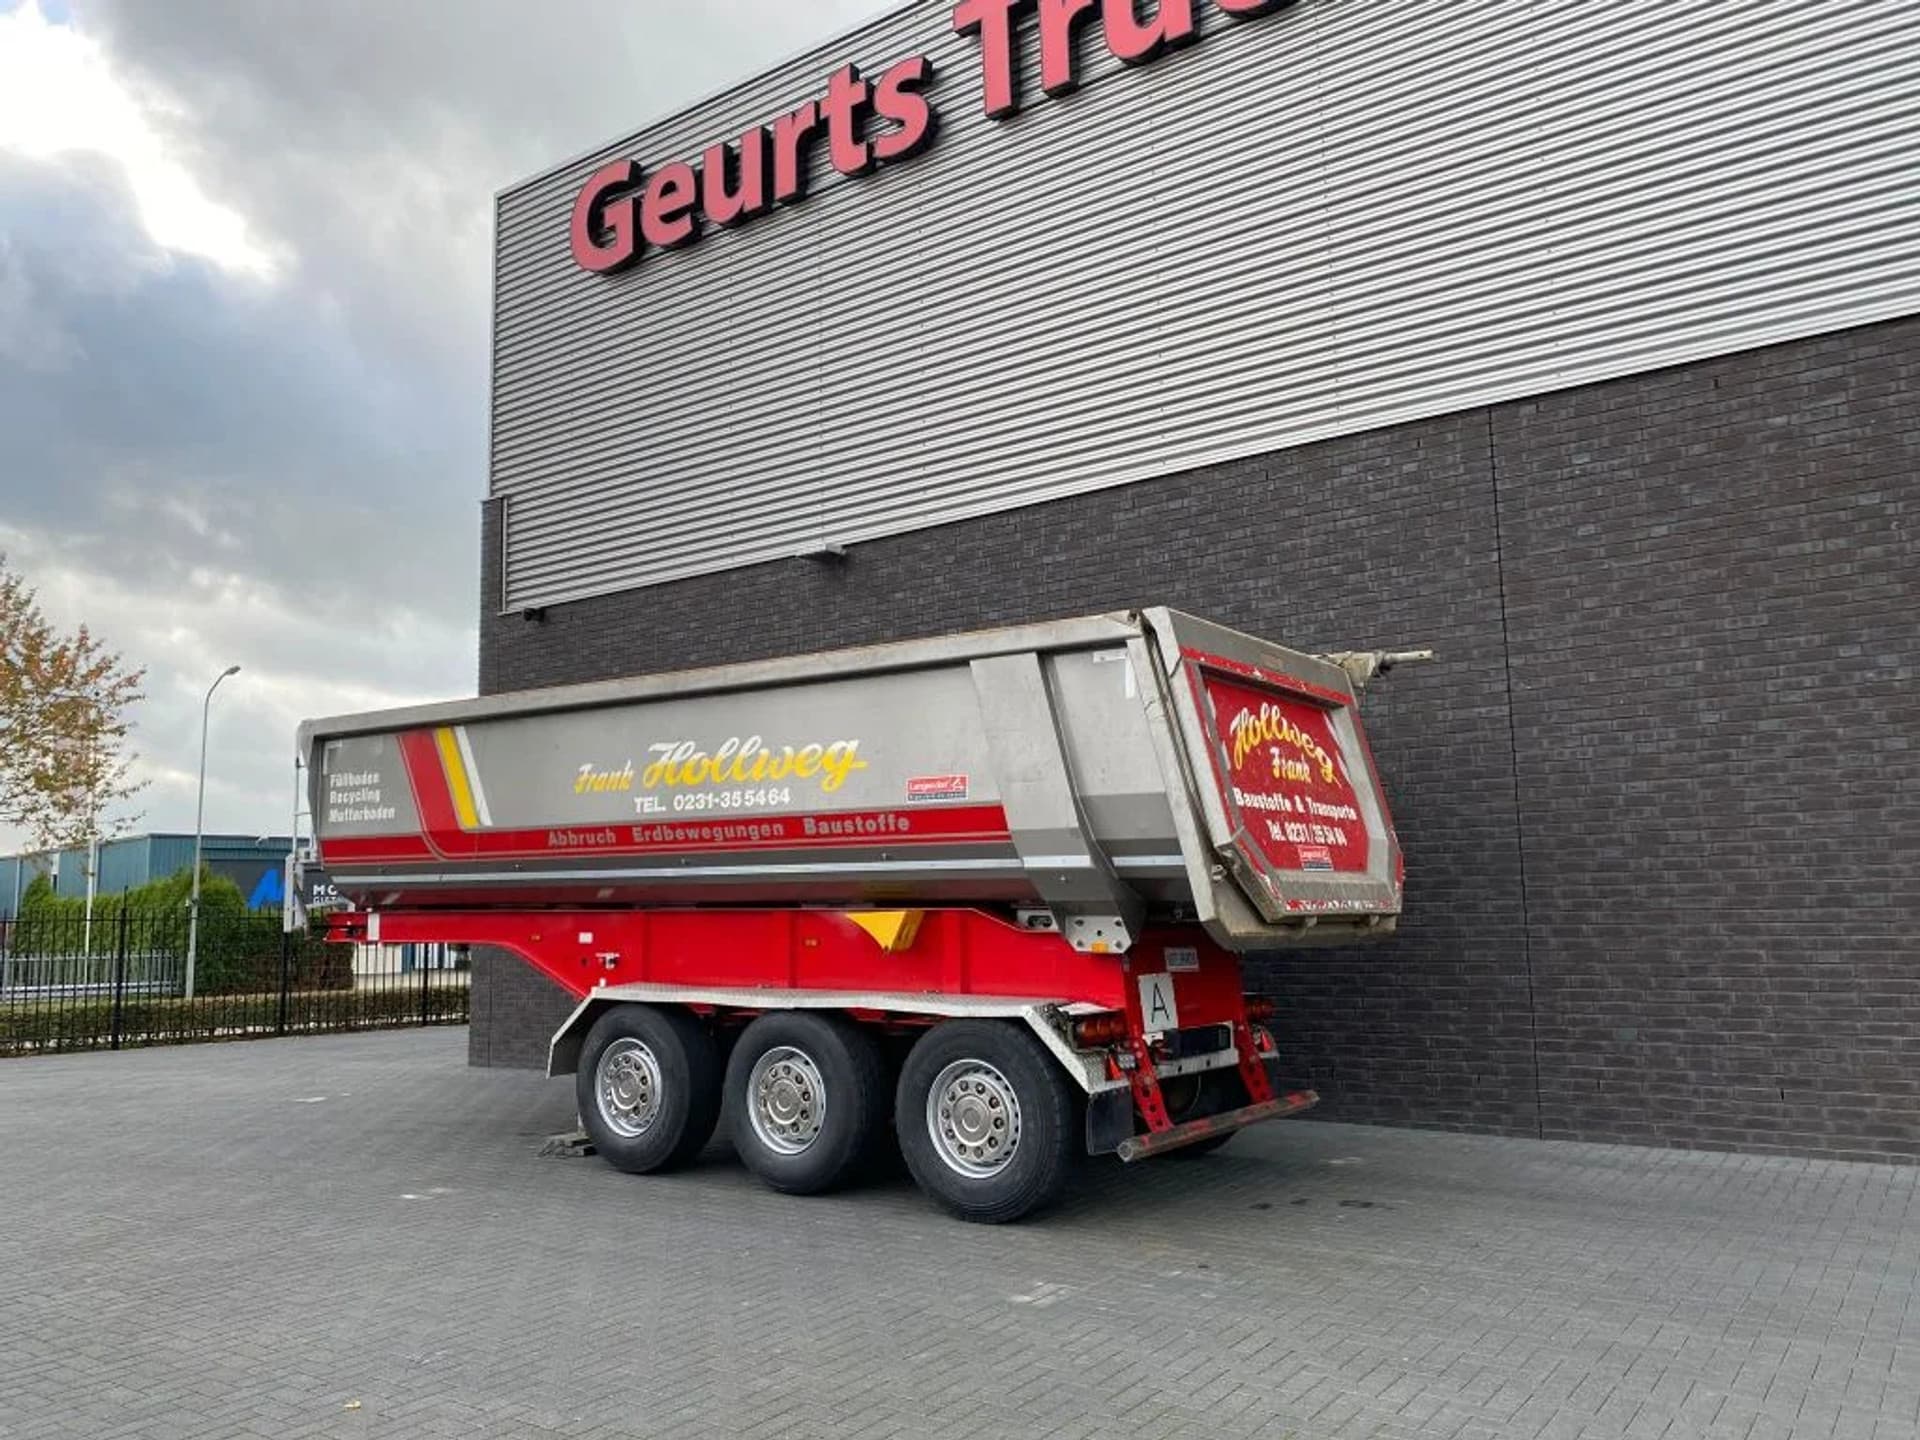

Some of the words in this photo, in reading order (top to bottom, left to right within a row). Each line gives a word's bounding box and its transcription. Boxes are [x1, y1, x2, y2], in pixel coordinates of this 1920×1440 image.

[570, 56, 934, 274] Geurts
[952, 0, 1284, 117] Tru
[1229, 702, 1342, 788] Hollweg
[574, 760, 634, 794] Frank
[643, 735, 868, 793] Hollweg
[1270, 746, 1312, 784] Frank
[329, 787, 381, 804] Recycling
[634, 797, 666, 814] TEL.
[1232, 787, 1292, 812] Baustoffe
[547, 827, 616, 848] Abbruch
[632, 821, 785, 843] Erdbewegungen
[803, 813, 910, 835] Baustoffe
[1151, 982, 1169, 1024] A
